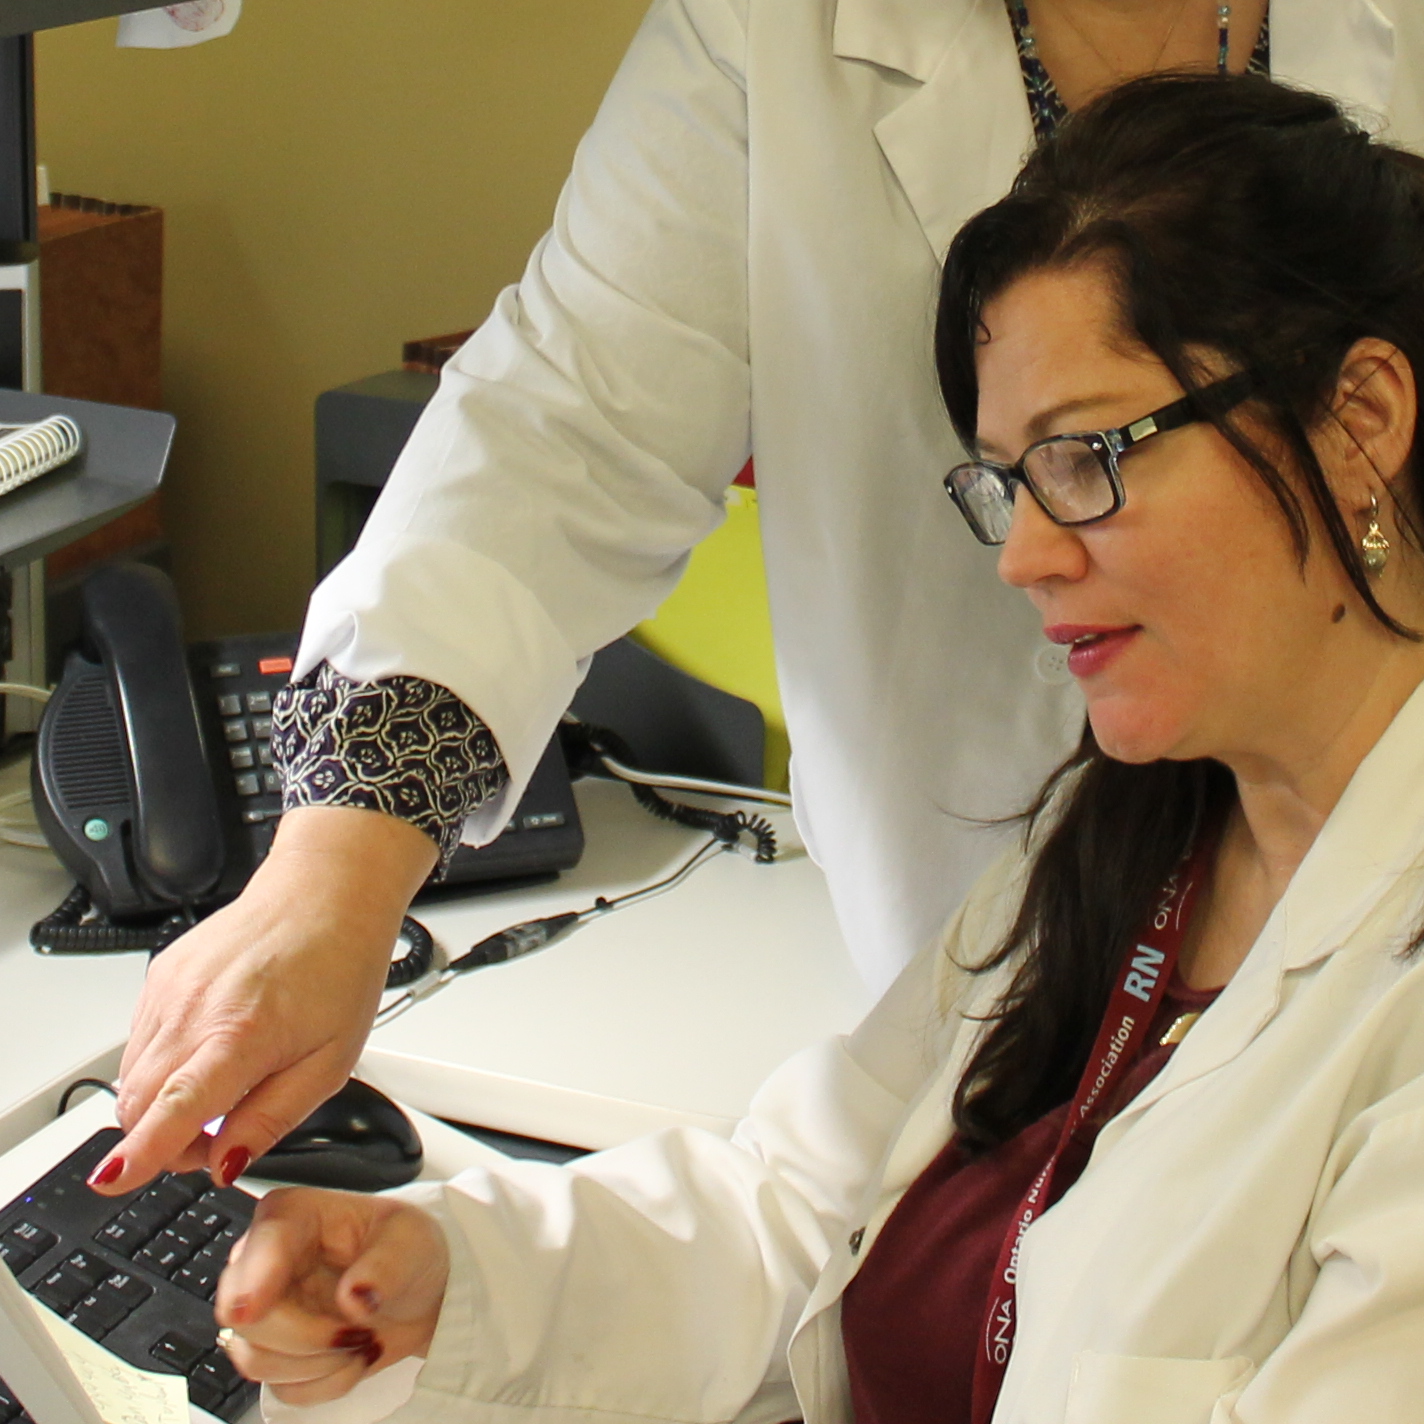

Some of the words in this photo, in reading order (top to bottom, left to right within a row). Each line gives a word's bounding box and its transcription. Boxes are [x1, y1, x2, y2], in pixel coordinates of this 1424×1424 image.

[1123, 943, 1166, 1003] RN
[1080, 1016, 1135, 1118] Association
[994, 1299, 1012, 1364] ONA
